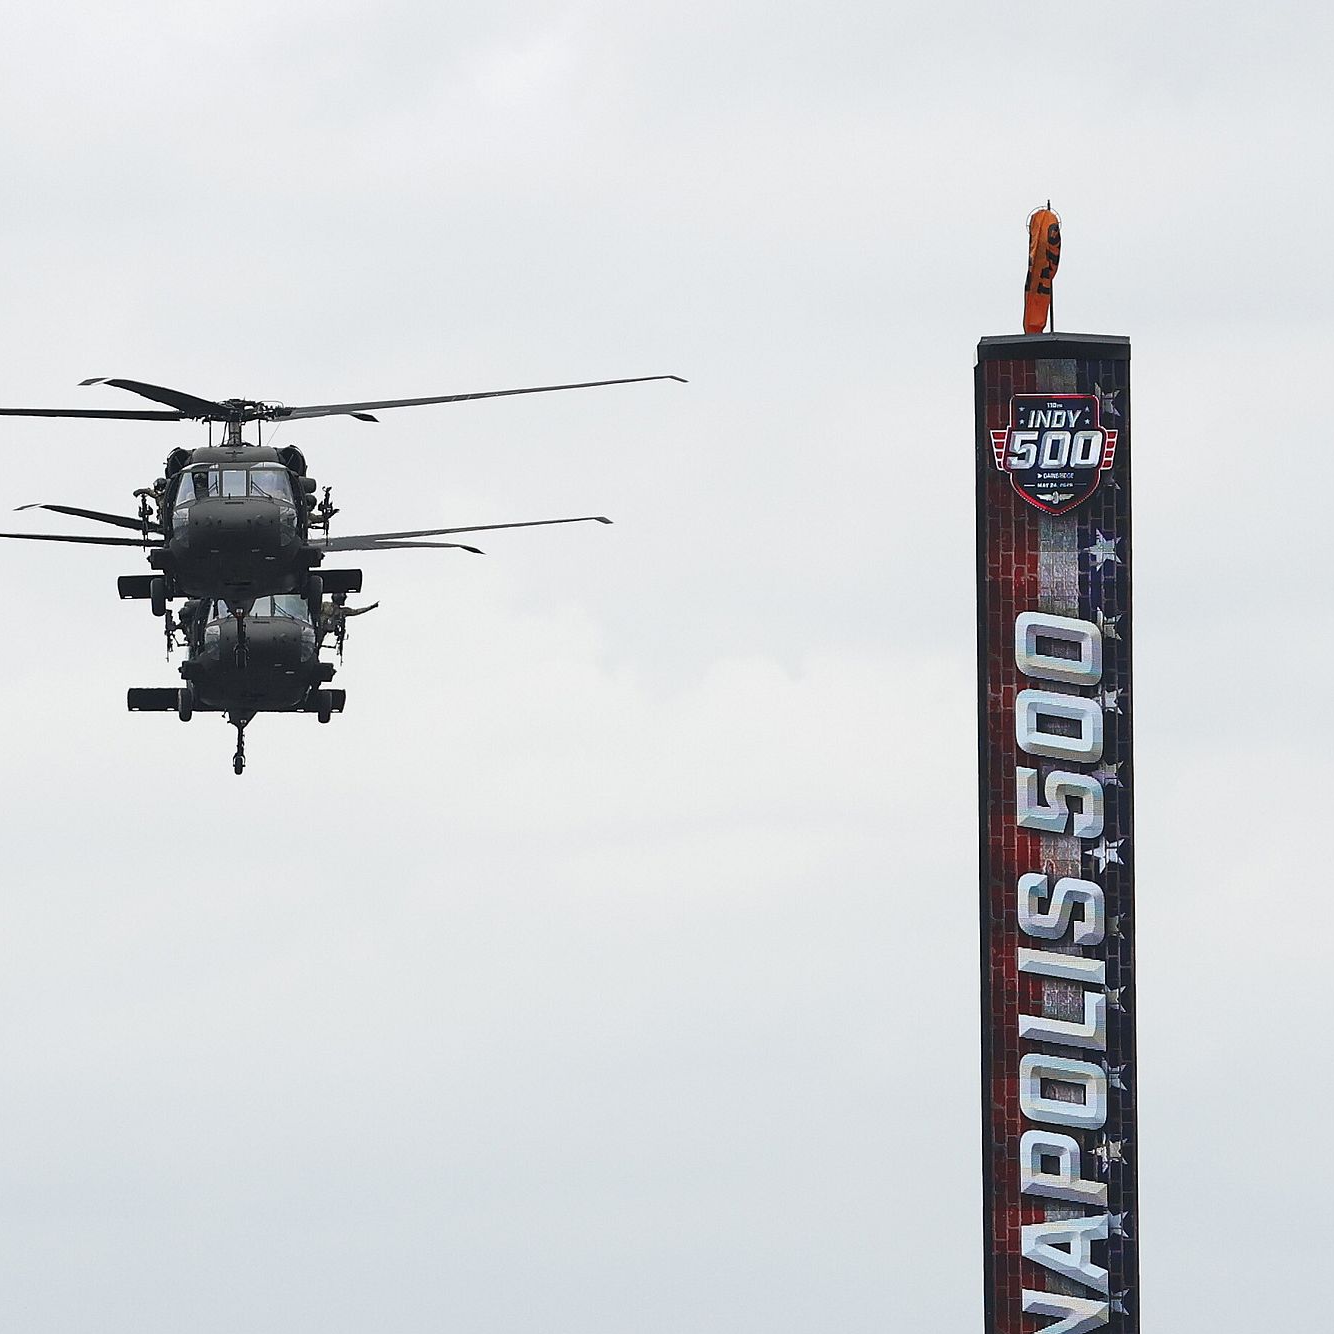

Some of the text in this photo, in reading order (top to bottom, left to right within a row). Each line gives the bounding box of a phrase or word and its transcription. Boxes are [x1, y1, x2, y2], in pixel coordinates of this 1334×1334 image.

[1027, 410, 1082, 428] INDY
[1007, 430, 1103, 470] 500
[1014, 610, 1105, 839] 500
